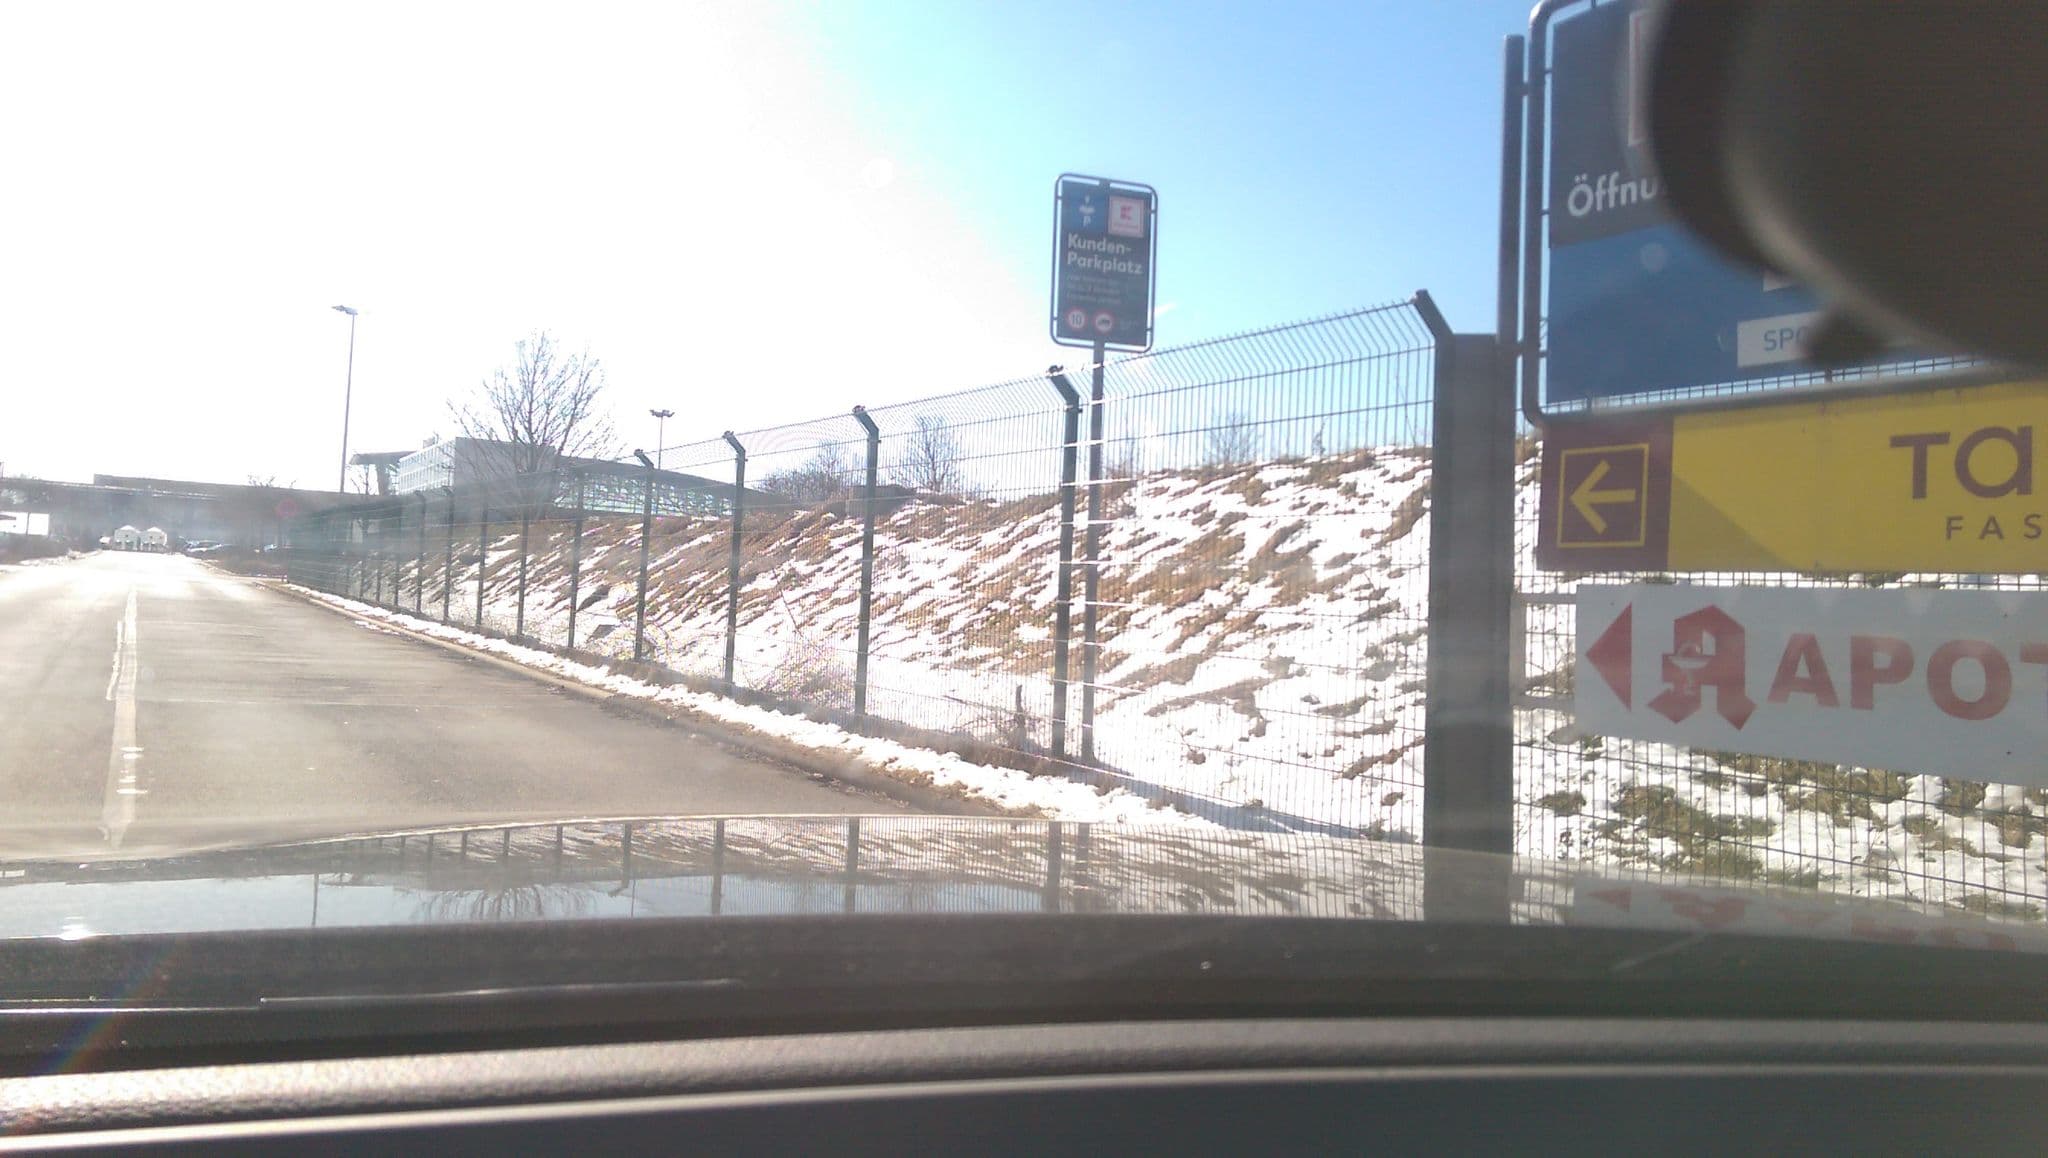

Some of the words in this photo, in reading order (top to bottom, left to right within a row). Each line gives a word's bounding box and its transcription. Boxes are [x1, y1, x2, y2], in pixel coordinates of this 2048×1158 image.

[1568, 172, 1659, 217] Öffnu
[1067, 233, 1132, 254] Kunden-
[1067, 251, 1144, 274] Parkplatz
[1071, 314, 1083, 326] 10
[1890, 425, 2033, 500] Ta
[1945, 513, 2043, 541] FAS
